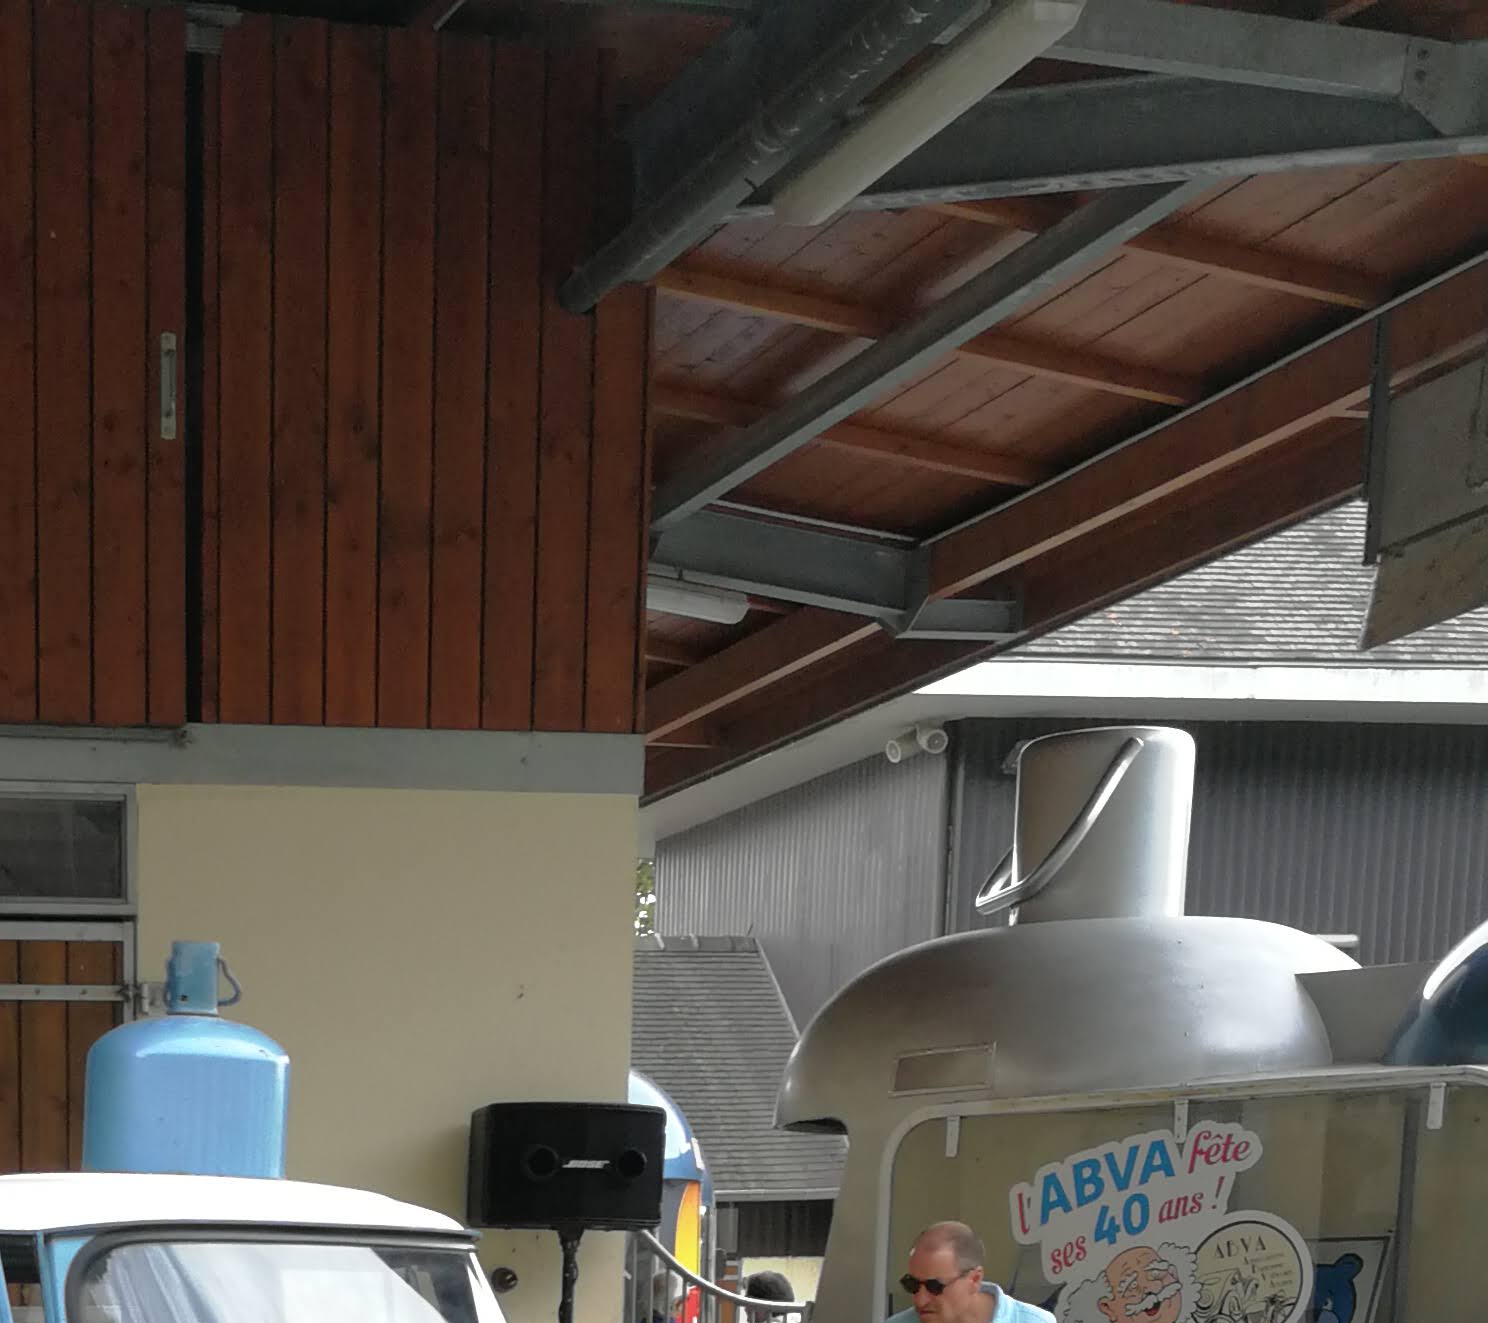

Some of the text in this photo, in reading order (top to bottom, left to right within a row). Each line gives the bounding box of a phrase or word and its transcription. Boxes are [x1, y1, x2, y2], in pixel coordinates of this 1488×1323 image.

[1017, 1130, 1250, 1235] l'ABVA fête
[1050, 1235, 1088, 1275] ses
[1094, 1192, 1150, 1245] 40
[1158, 1192, 1205, 1224] ans
[1214, 1235, 1267, 1259] ABVA
